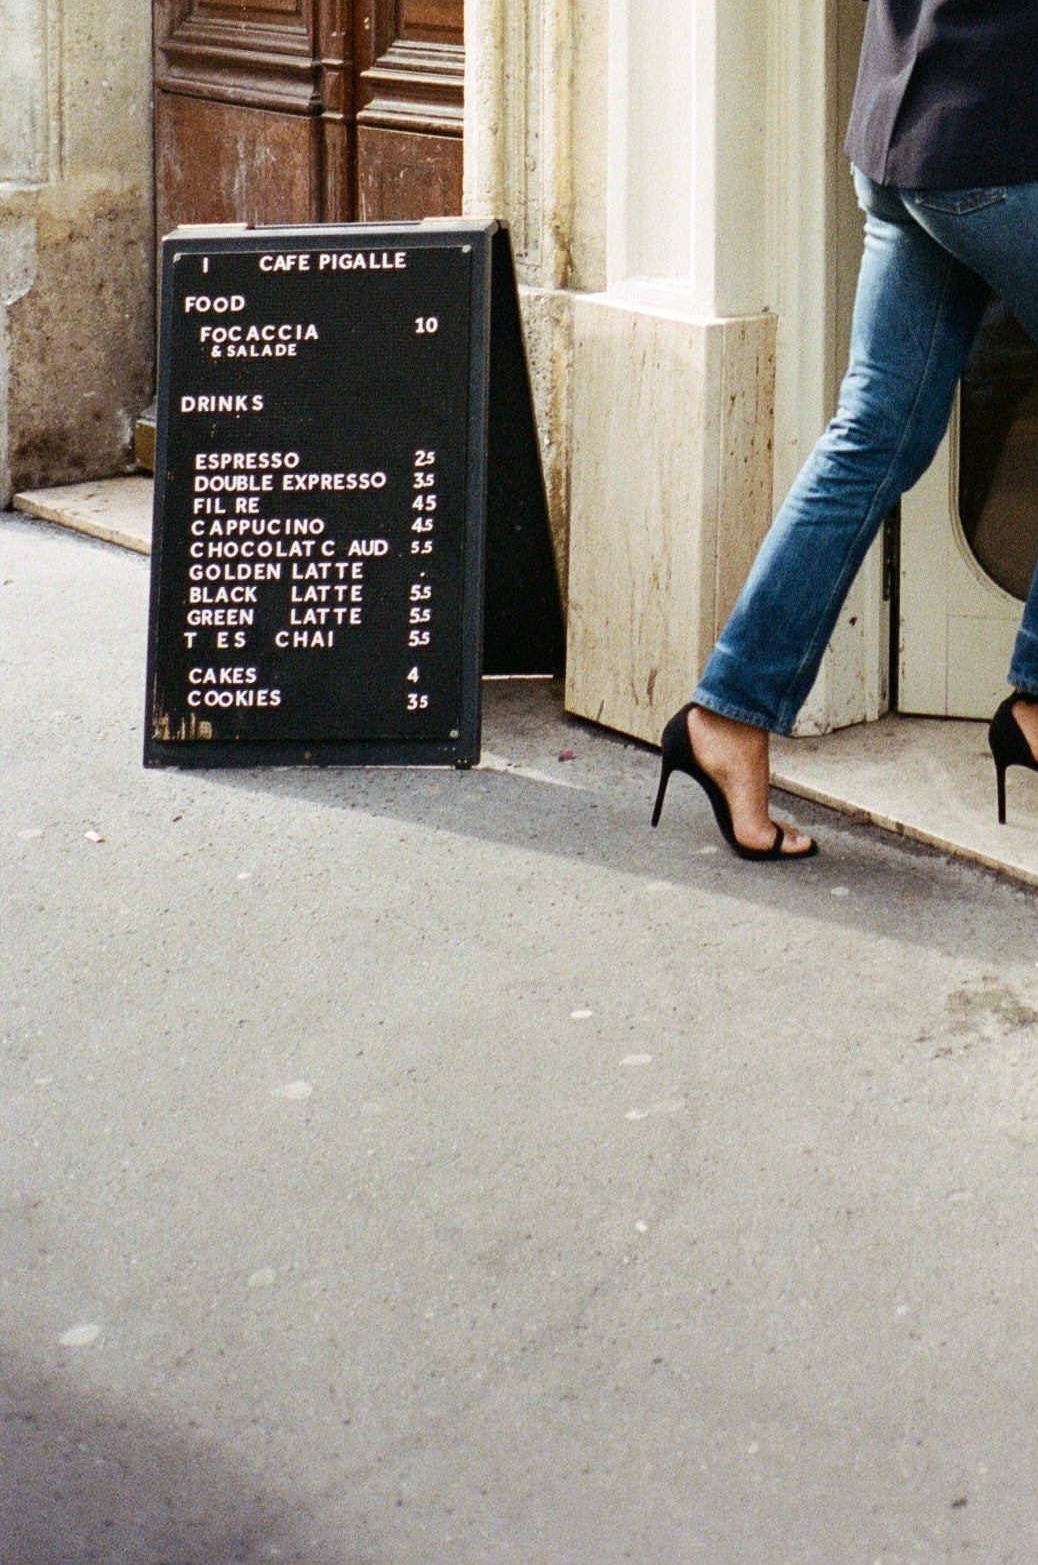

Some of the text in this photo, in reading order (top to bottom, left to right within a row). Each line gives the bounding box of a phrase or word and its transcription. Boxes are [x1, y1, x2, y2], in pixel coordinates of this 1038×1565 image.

[259, 254, 311, 272] CAFE
[319, 251, 407, 271] PIGALLE
[184, 294, 246, 313] FOOD
[200, 316, 439, 344] FOCACCIA 10
[210, 343, 297, 358] & SALADE
[181, 394, 264, 413] DRINKS
[195, 451, 300, 470] ESPRESSO
[194, 474, 274, 492] DOUBLE
[282, 471, 387, 491] EXPRESSO
[190, 517, 325, 536] CAPPUCINO
[188, 561, 364, 581] GOLDEN LATTE
[189, 585, 258, 604] BLACK
[291, 584, 363, 603] LATTE
[186, 608, 254, 626] GREEN
[290, 607, 362, 625] LATTE
[275, 630, 334, 648] CHAI
[188, 666, 419, 684] CAKES 4
[187, 688, 282, 708] COOKIES
